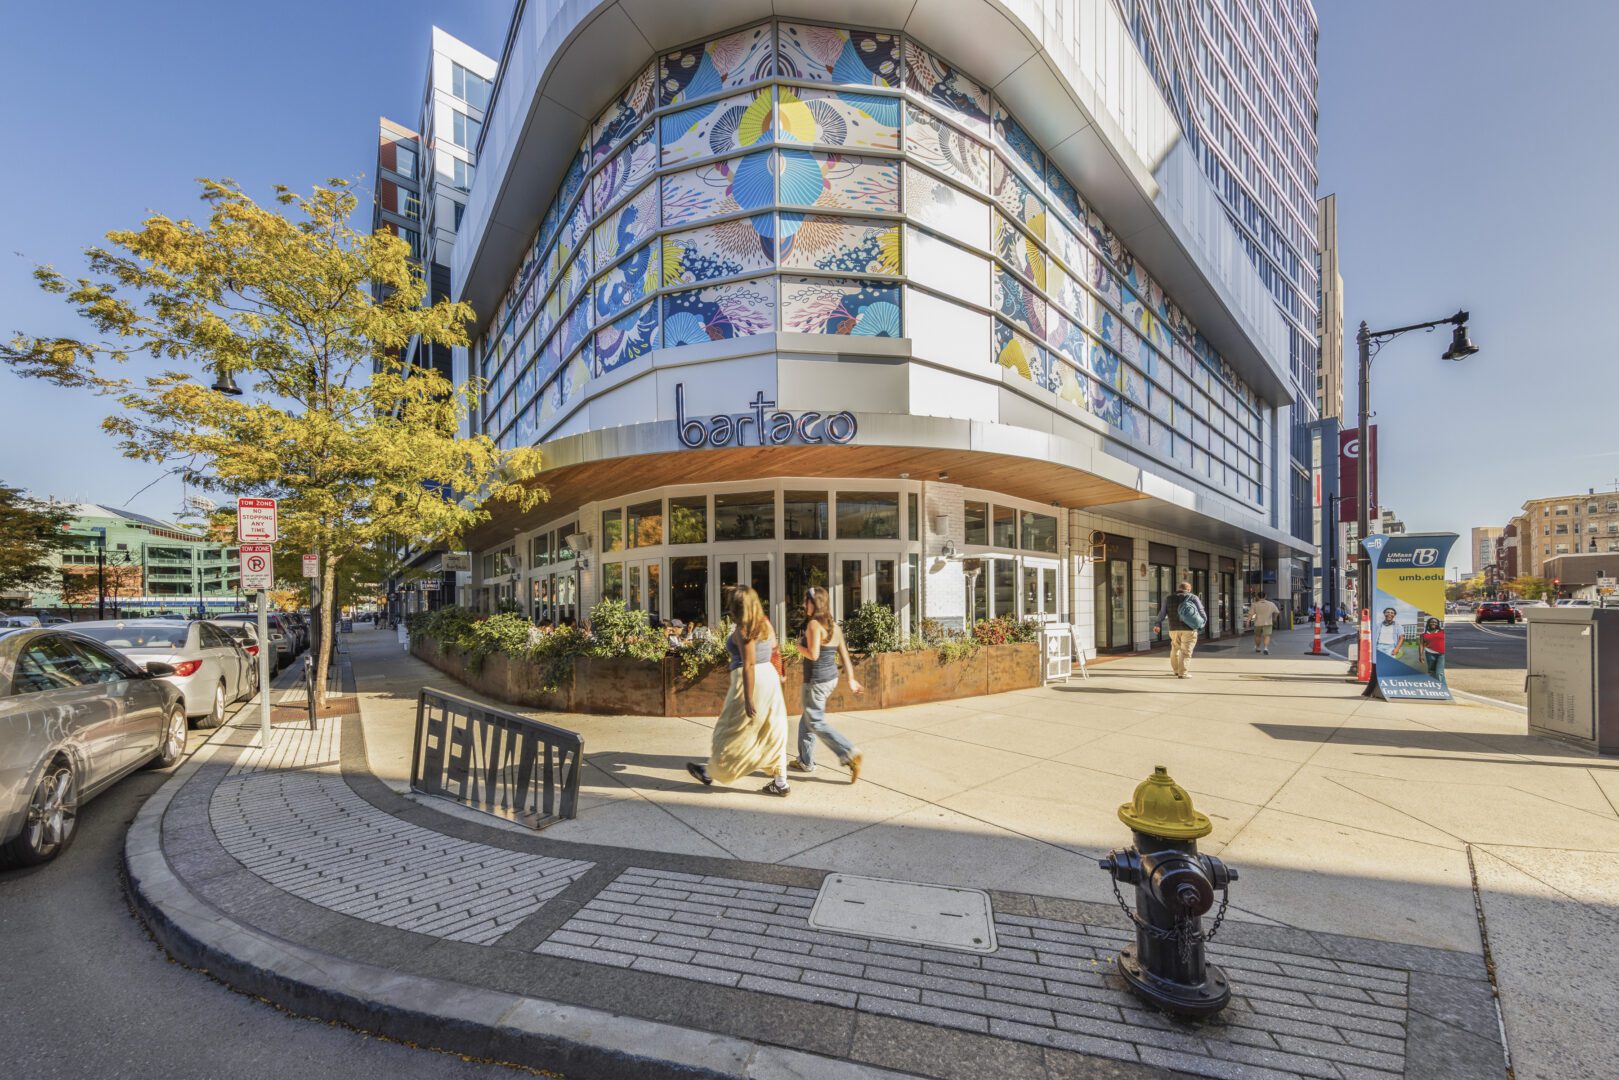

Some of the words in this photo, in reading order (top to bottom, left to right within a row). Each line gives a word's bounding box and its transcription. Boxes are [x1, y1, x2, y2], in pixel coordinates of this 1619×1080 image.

[676, 383, 858, 449] bartaco
[1389, 680, 1442, 689] University
[1400, 688, 1416, 696] the
[1417, 688, 1450, 697] Times
